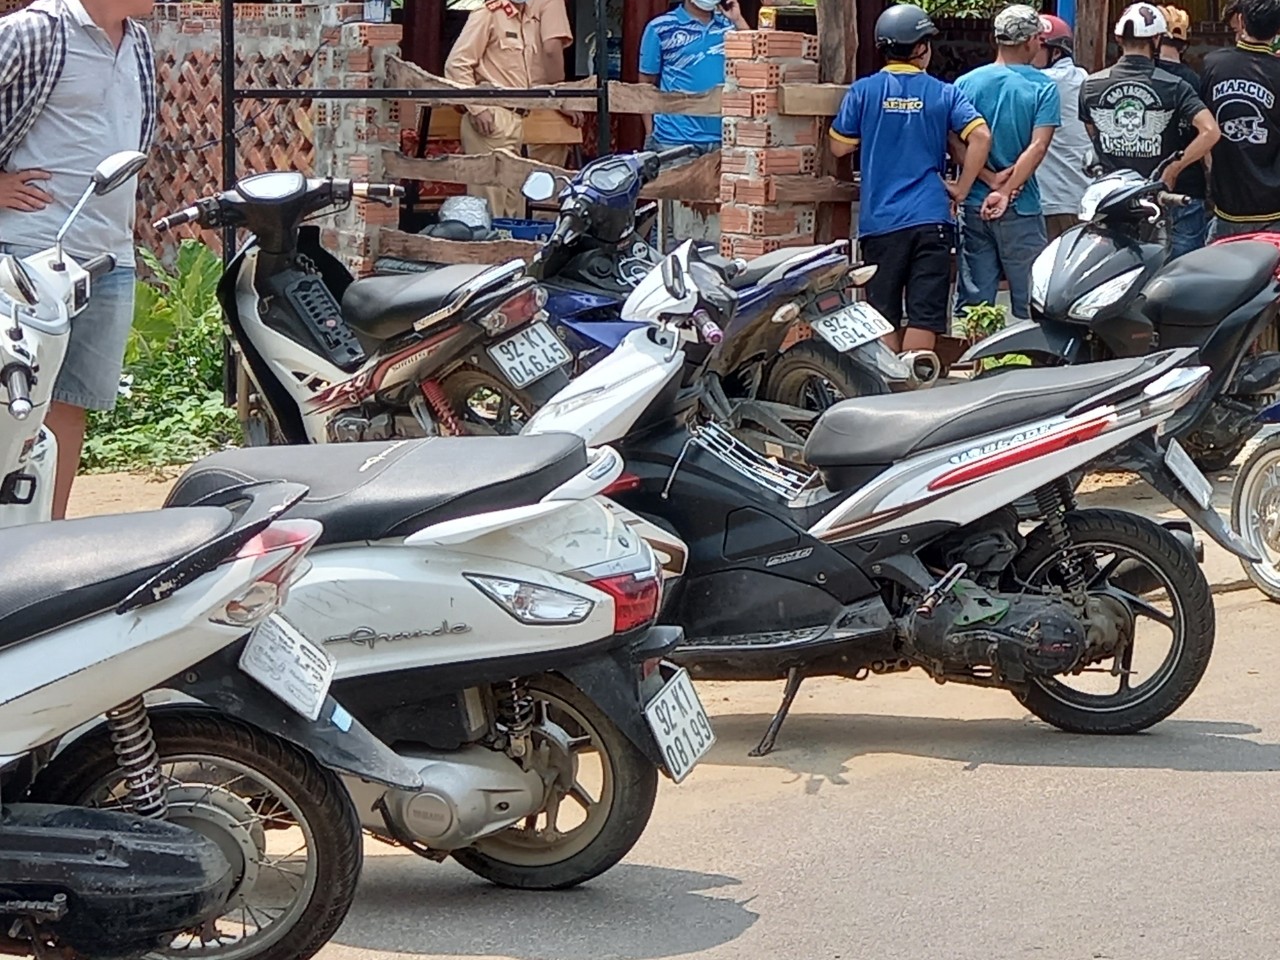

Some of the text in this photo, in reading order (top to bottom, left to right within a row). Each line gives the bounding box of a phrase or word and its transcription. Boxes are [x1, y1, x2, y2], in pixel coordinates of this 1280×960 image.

[1213, 79, 1275, 109] MARCUS
[499, 327, 546, 361] 92-K1
[509, 342, 566, 383] 046.45
[322, 619, 472, 649] Grande
[655, 681, 693, 736] 92-K1
[666, 710, 711, 776] 081.99
